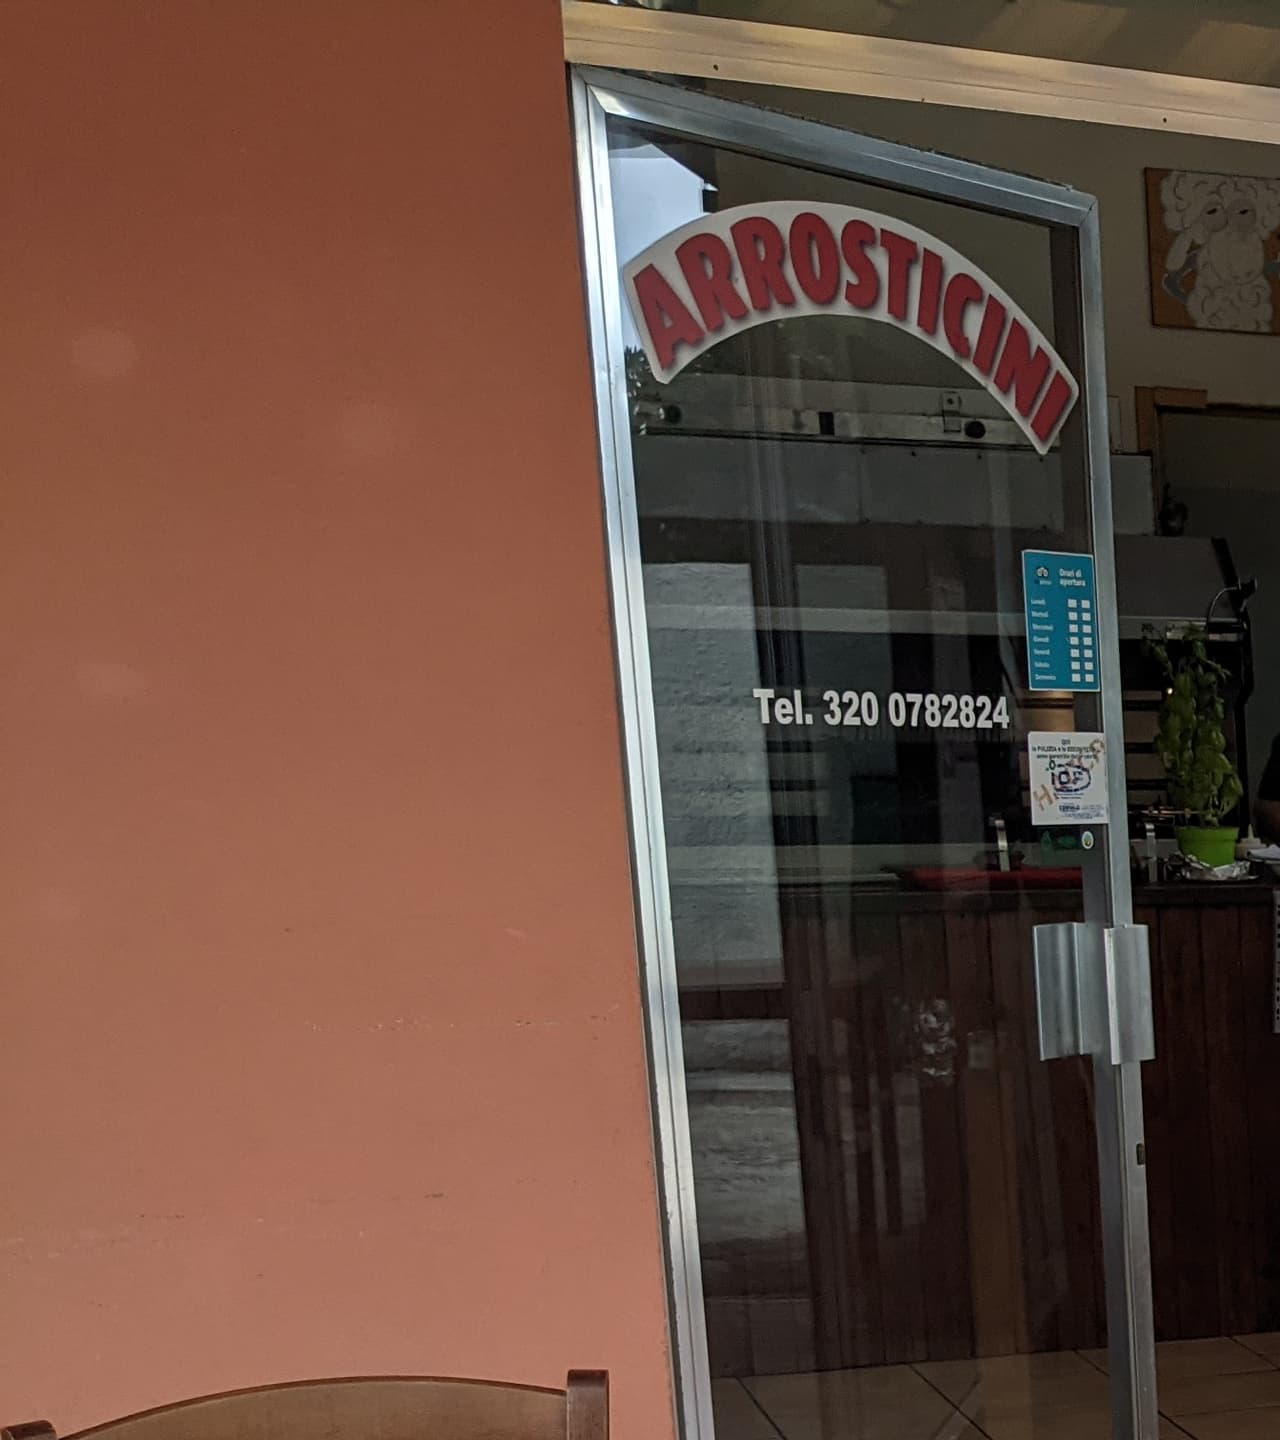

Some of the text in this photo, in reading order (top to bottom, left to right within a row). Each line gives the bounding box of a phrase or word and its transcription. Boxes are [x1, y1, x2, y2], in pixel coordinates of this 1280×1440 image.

[632, 211, 1073, 443] ARROSTICINI
[753, 688, 1010, 729] Tel. 320 0782824
